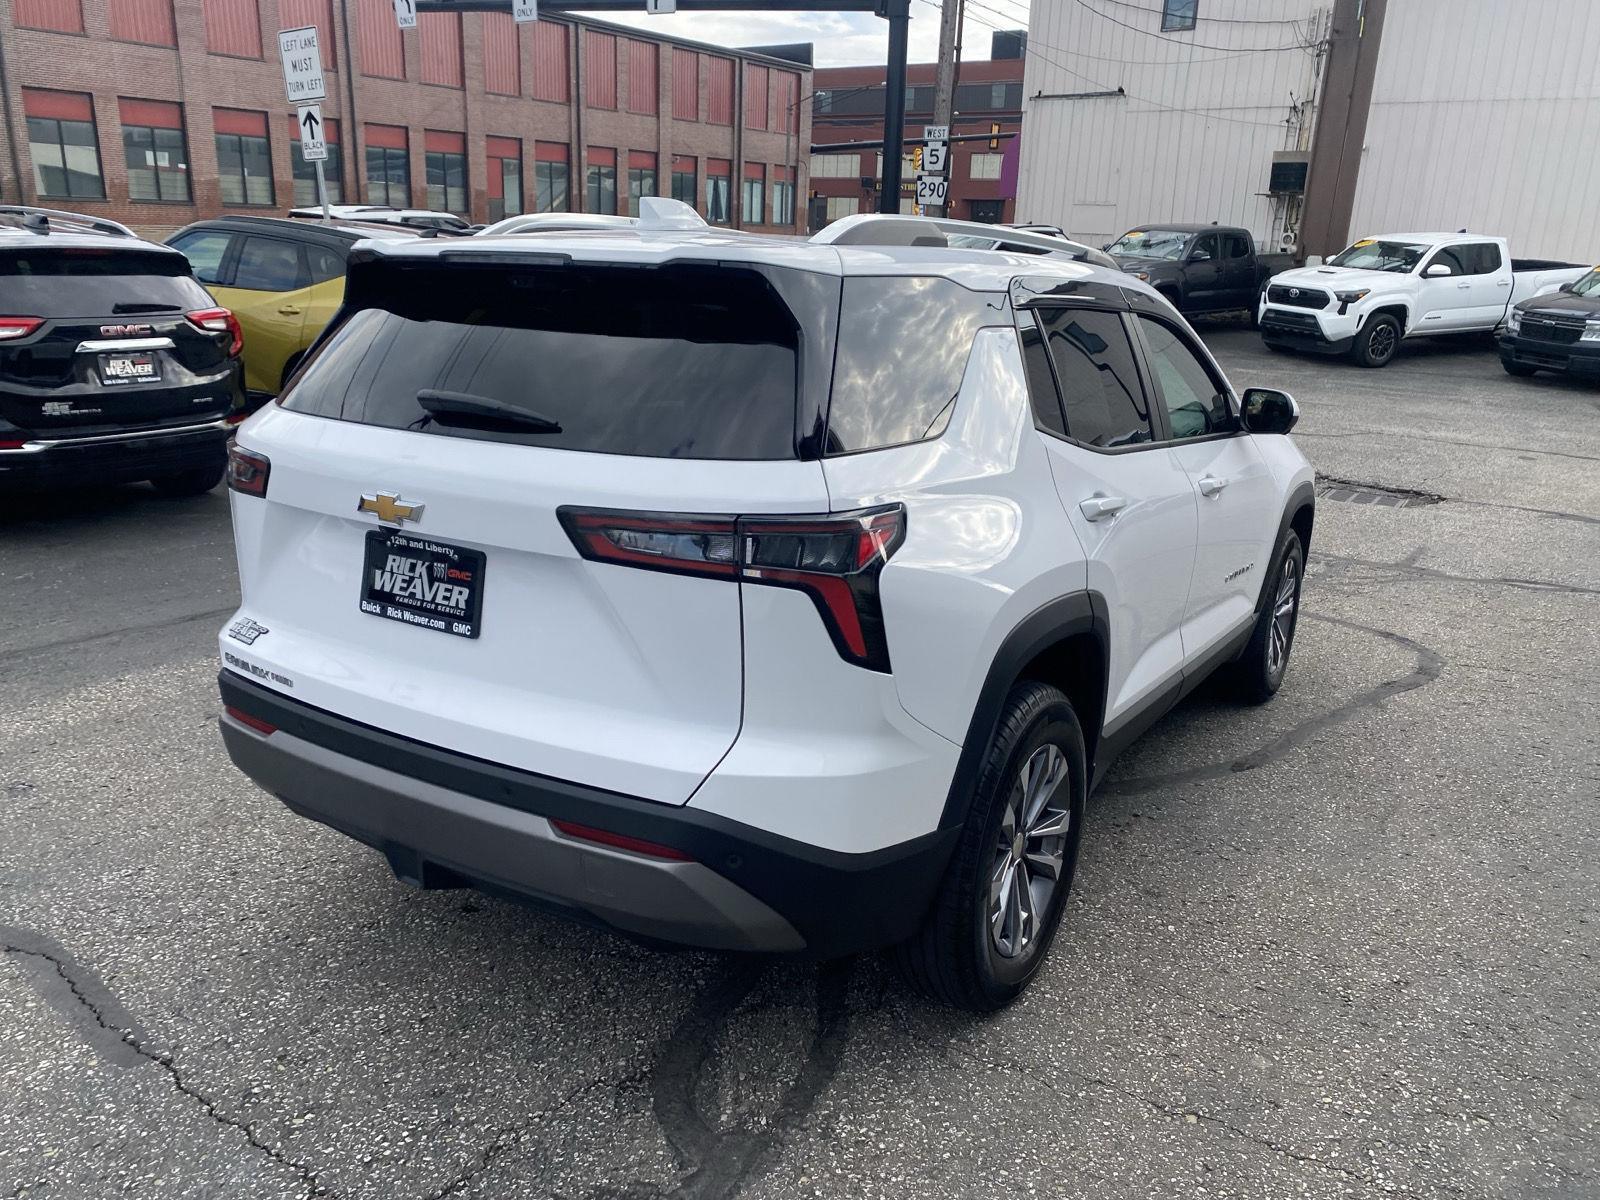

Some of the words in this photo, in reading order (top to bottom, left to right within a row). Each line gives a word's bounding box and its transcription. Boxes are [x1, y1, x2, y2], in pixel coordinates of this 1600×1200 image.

[517, 8, 533, 17] ONLY
[400, 16, 414, 25] ONLY
[283, 39, 298, 51] LEFT
[300, 36, 316, 49] LANE
[291, 57, 313, 73] MUST
[288, 81, 305, 93] TURN
[307, 78, 322, 91] LEFT
[926, 128, 946, 139] WEST
[929, 149, 940, 164] 5
[919, 181, 945, 198] 290
[100, 324, 152, 336] GMC
[105, 364, 153, 376] WEAVER
[390, 535, 408, 546] 12th
[409, 539, 424, 549] and
[425, 542, 455, 557] Liberty
[385, 554, 431, 578] RICK
[447, 568, 472, 581] GMC
[374, 569, 470, 609] WEAVER
[395, 596, 421, 607] FAMOUS
[423, 601, 435, 610] FOR
[437, 605, 465, 617] SERVICE
[361, 600, 381, 614] Buick
[387, 606, 402, 618] Rick
[403, 610, 445, 629] Weaver.com
[452, 622, 471, 635] GMC
